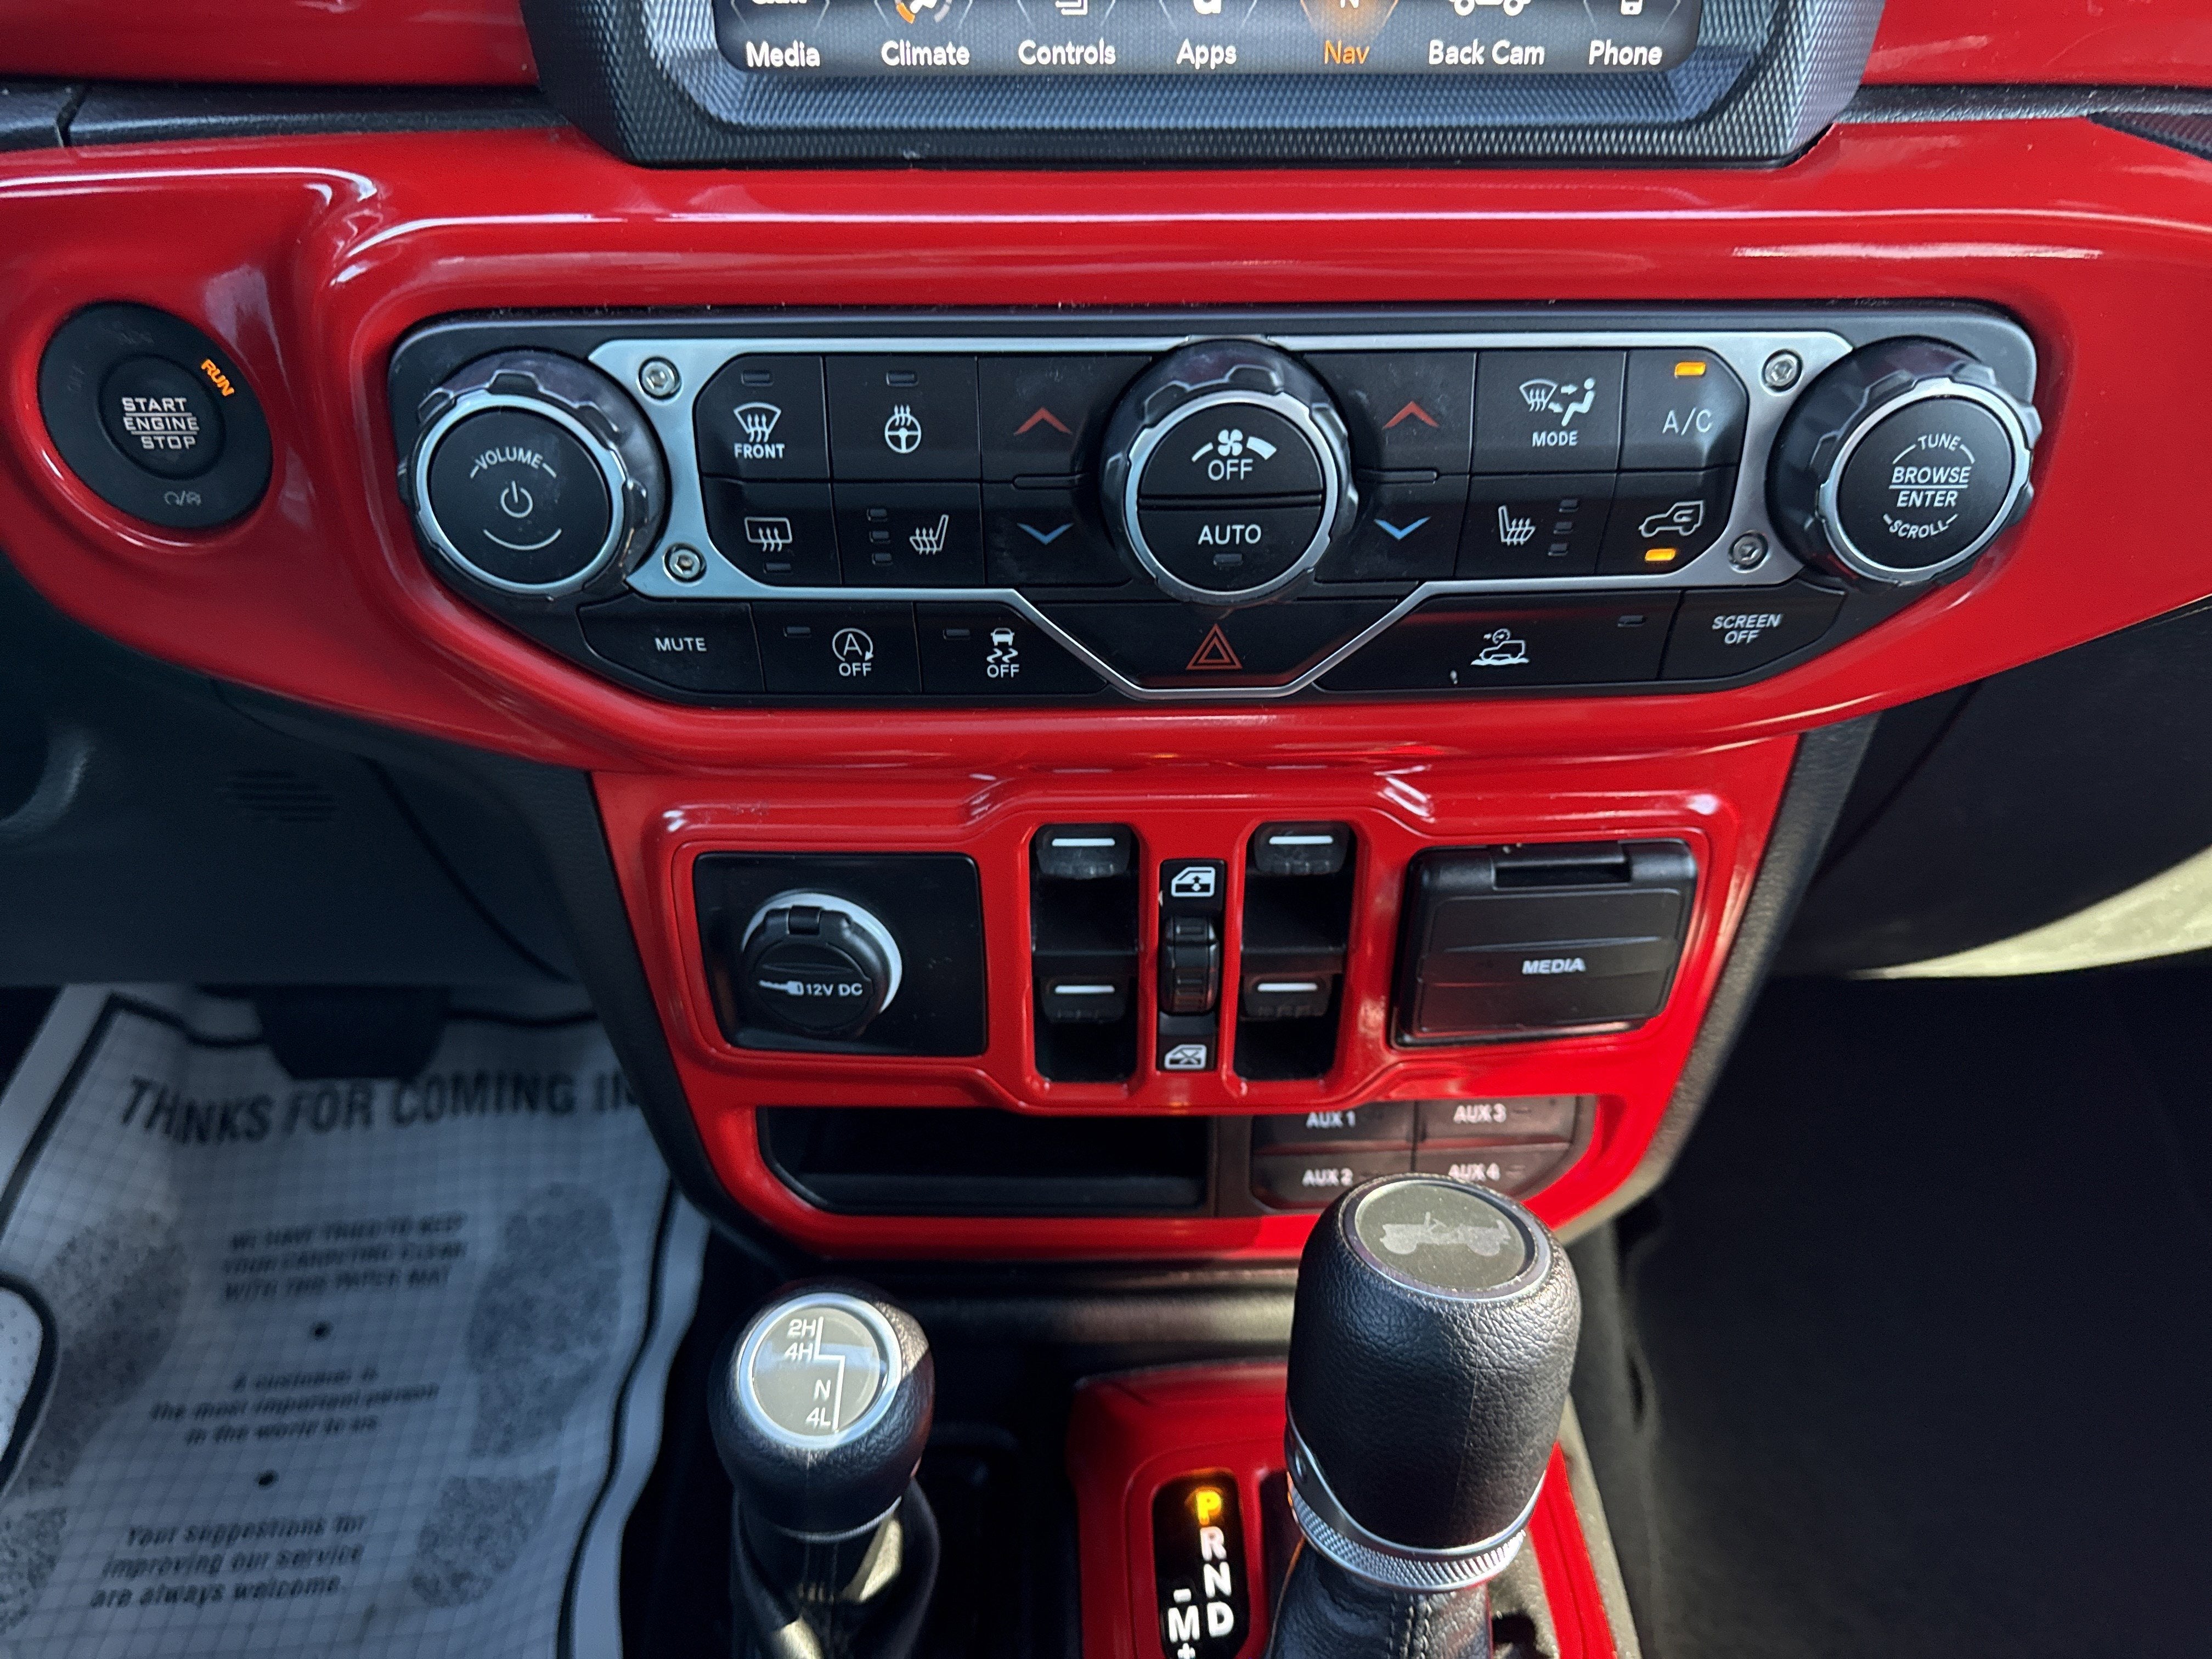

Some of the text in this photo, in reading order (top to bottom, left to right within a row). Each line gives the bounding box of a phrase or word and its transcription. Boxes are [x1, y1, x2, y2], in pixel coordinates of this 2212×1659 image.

[746, 41, 821, 68] Media
[881, 40, 970, 66] Climate
[1018, 38, 1116, 65] Controls
[1176, 38, 1237, 70] Apps
[1324, 40, 1370, 64] Nav
[1428, 39, 1545, 66] Back Cam
[1589, 40, 1663, 66] Phone
[201, 358, 235, 397] RUN
[122, 397, 187, 411] START
[123, 416, 200, 431] ENGINE
[1662, 408, 1712, 436] A/C
[141, 436, 196, 450] STOP
[1532, 431, 1578, 447] MODE
[1917, 433, 1961, 451] TUNE
[476, 445, 543, 471] VOLUME
[734, 444, 785, 459] FRONT
[1207, 459, 1253, 481] OFF
[1891, 466, 1972, 484] BROWSE
[1897, 491, 1959, 507] ENTER
[1198, 524, 1261, 545] AUTO
[1889, 520, 1949, 539] SCROLL
[1712, 613, 1781, 630] SCREEN
[655, 637, 707, 653] MUTE
[1724, 629, 1759, 645] OFF
[838, 662, 872, 677] OFF
[987, 664, 1020, 679] OFF
[1521, 957, 1586, 975] MEDIA
[806, 983, 864, 996] 12V DC
[121, 1075, 273, 1144] THNKS
[391, 1070, 577, 1128] COMING
[1453, 1103, 1507, 1124] AUX 3
[1306, 1111, 1356, 1128] AUX 1
[1302, 1168, 1353, 1187] AUX 2
[1448, 1163, 1500, 1181] AUX 4
[788, 1319, 816, 1338] 2H
[785, 1342, 813, 1361] 4H
[814, 1379, 831, 1400] N
[806, 1407, 832, 1427] 4L
[1196, 1491, 1222, 1525] P
[1200, 1526, 1227, 1561] R
[1203, 1561, 1232, 1599] N
[1168, 1605, 1200, 1643] M
[1207, 1601, 1234, 1638] D
